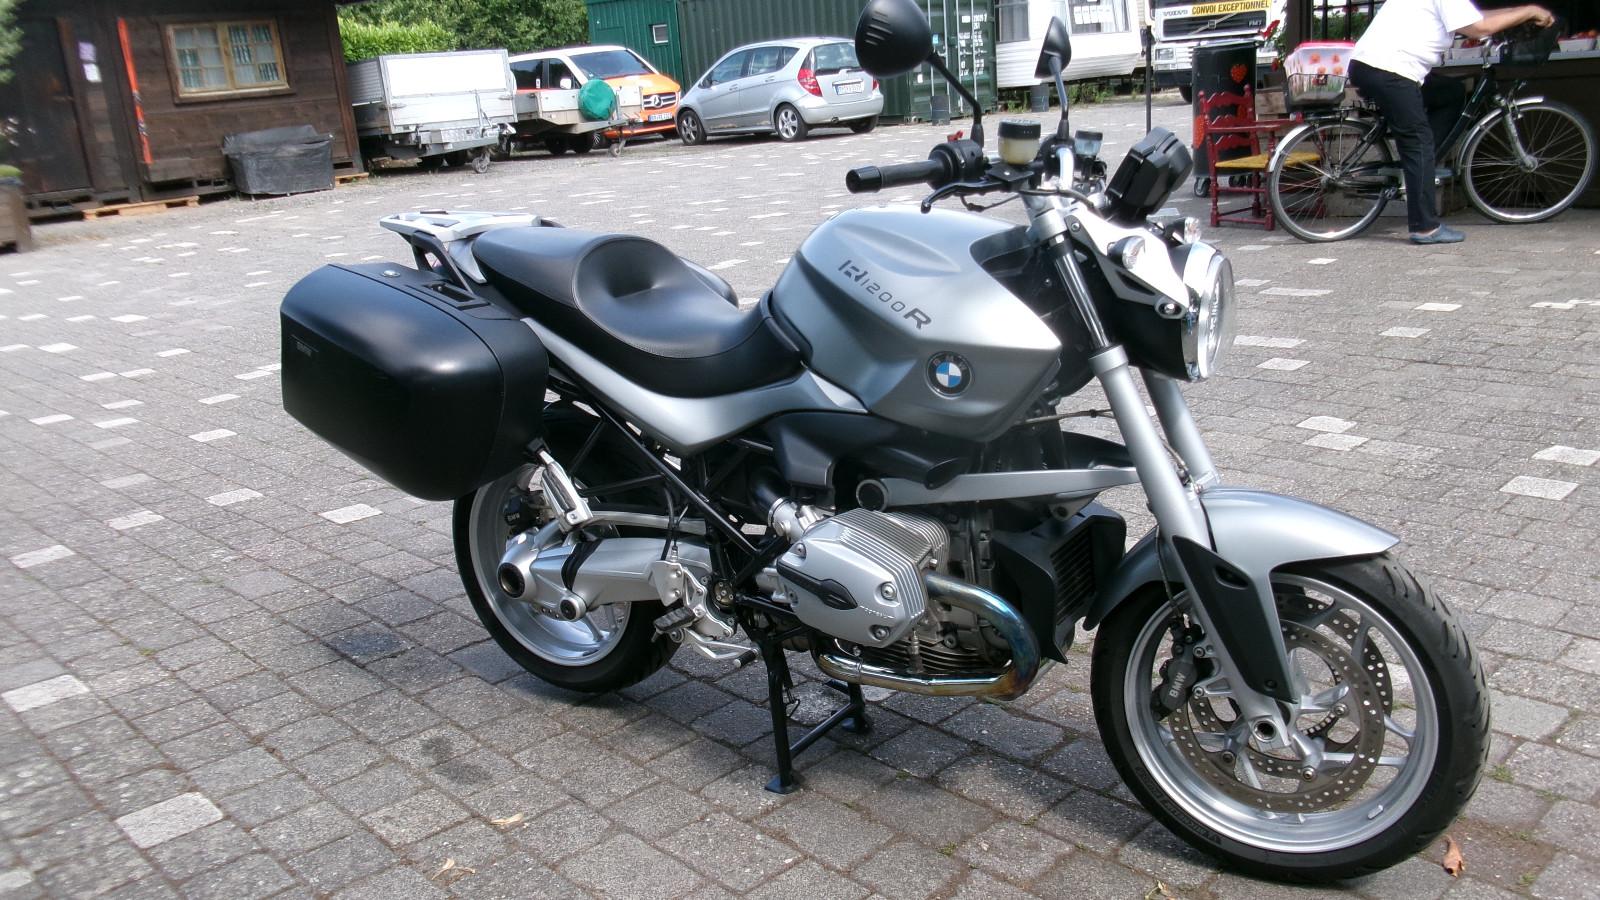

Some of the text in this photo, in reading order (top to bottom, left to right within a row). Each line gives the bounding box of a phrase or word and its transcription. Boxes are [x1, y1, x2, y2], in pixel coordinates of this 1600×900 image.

[1191, 0, 1270, 15] CONVOI EXCEPTIONNEL
[1169, 672, 1187, 698] BMW
